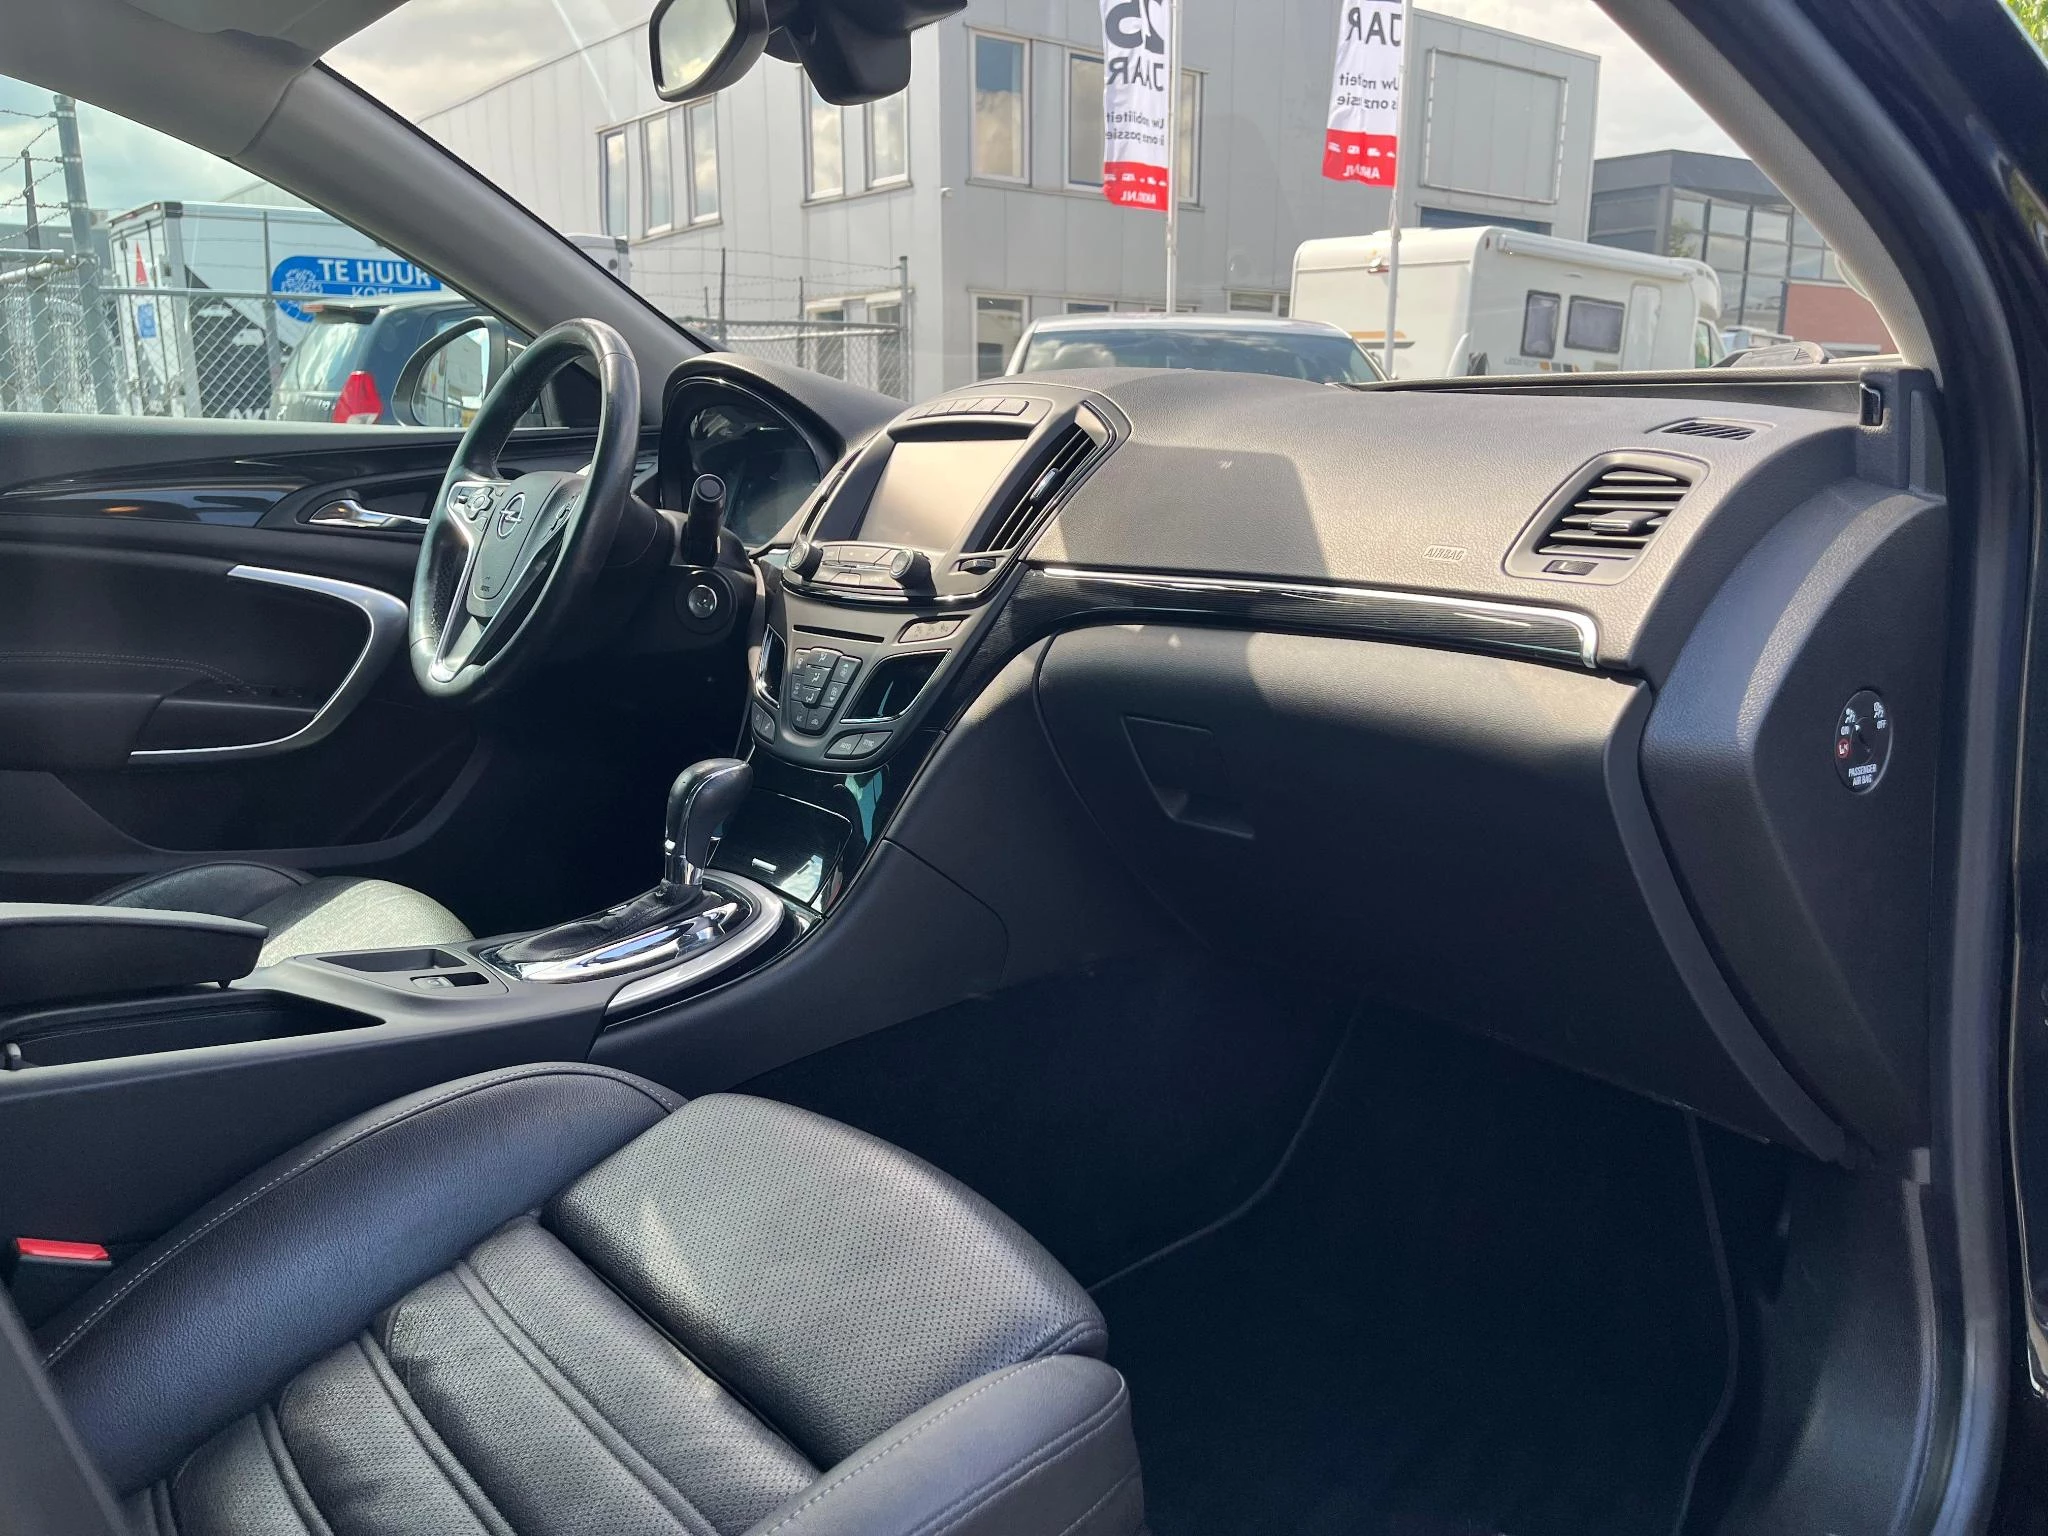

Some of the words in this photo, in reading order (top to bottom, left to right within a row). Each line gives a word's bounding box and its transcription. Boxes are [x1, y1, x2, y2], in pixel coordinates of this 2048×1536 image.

[317, 259, 350, 282] TE
[357, 261, 432, 288] HUUR
[1877, 720, 1887, 729] OFF
[1848, 764, 1877, 777] PASSENGER
